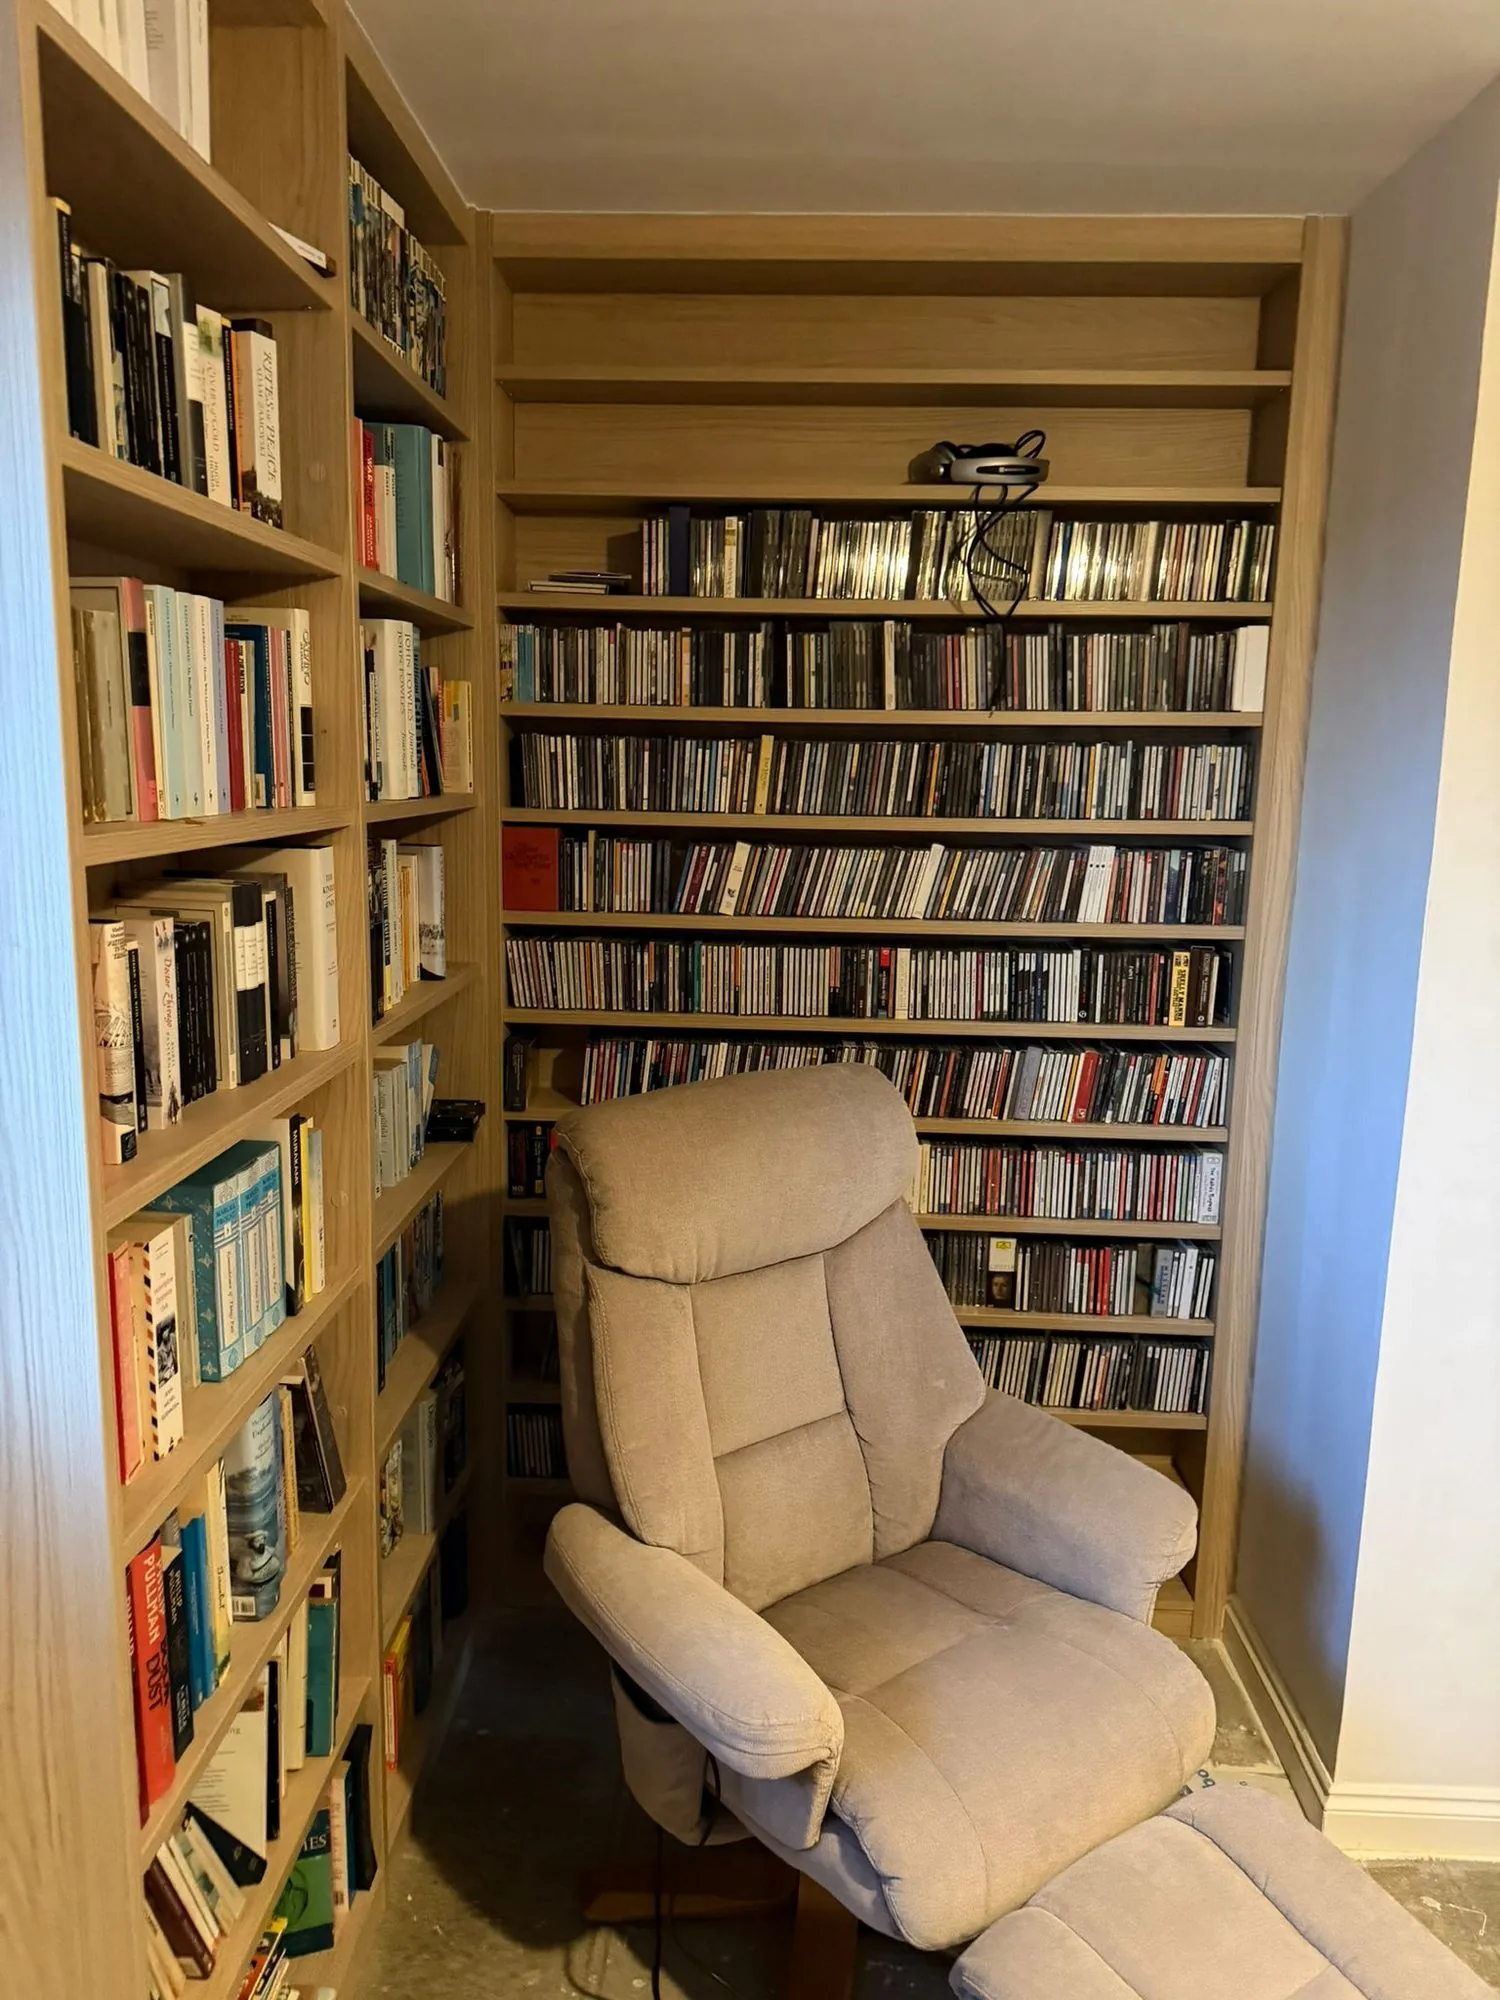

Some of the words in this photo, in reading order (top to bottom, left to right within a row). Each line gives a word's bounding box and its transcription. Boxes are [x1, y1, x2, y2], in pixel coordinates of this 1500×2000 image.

[263, 351, 273, 411] RITES
[266, 425, 276, 484] PEACE
[404, 633, 412, 668] JOHN
[408, 730, 416, 770] Journals
[163, 957, 172, 988] Doctor
[163, 991, 173, 1034] Zhivago
[291, 1129, 299, 1185] MURAKAMI
[144, 1552, 160, 1645] PULLMAN
[170, 1569, 178, 1625] PULLMAN
[146, 1652, 164, 1711] DUST
